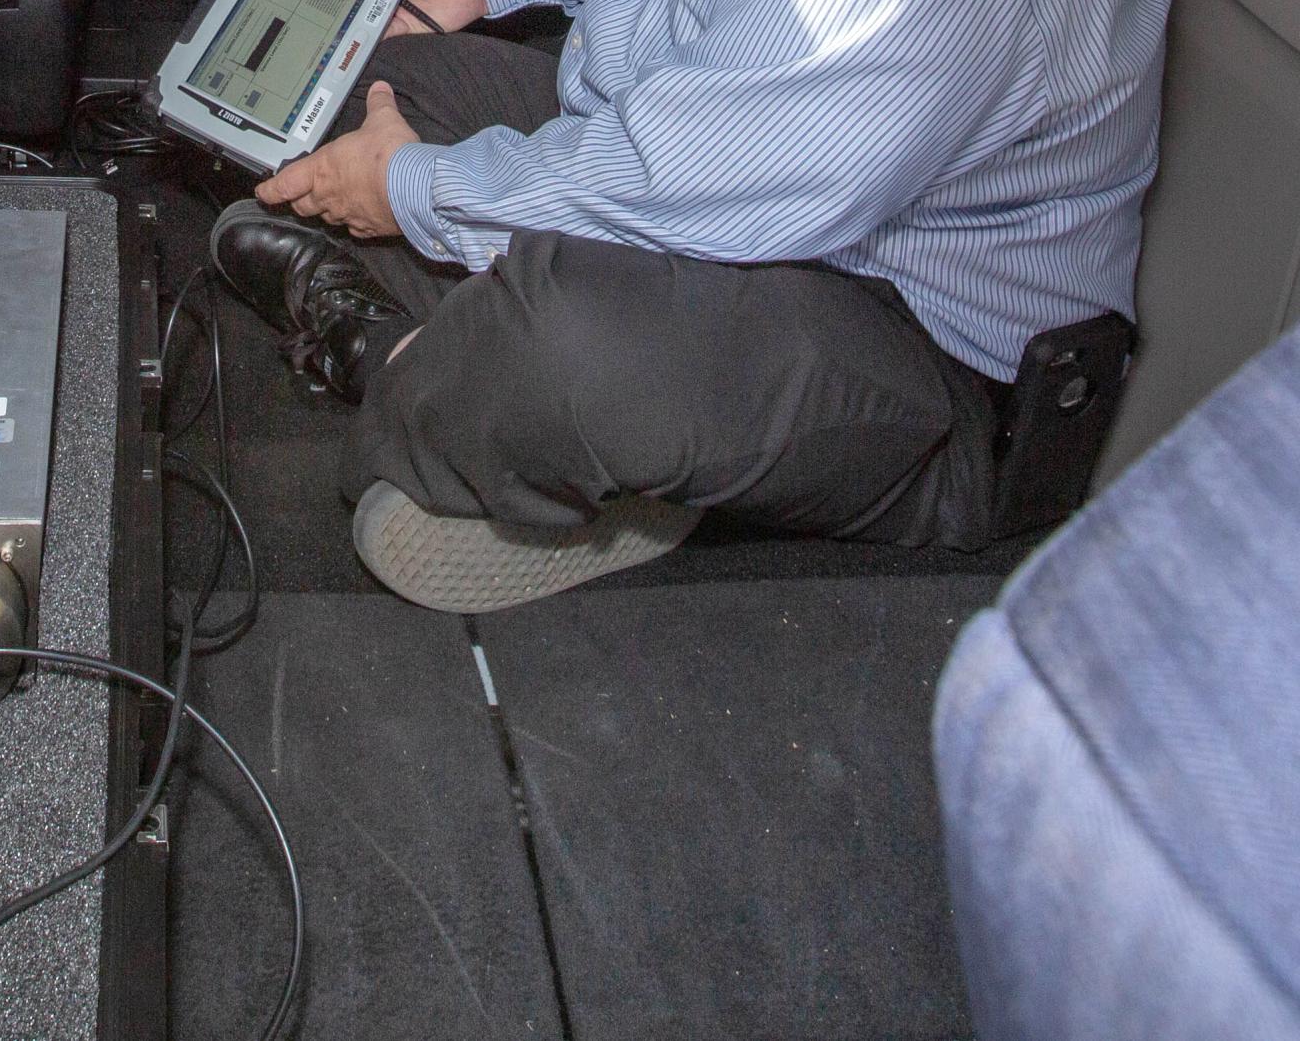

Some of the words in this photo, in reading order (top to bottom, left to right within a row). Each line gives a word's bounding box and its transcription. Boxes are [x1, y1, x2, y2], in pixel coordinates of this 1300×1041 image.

[338, 40, 361, 72] handheld
[305, 96, 325, 124] Master
[301, 125, 310, 133] A
